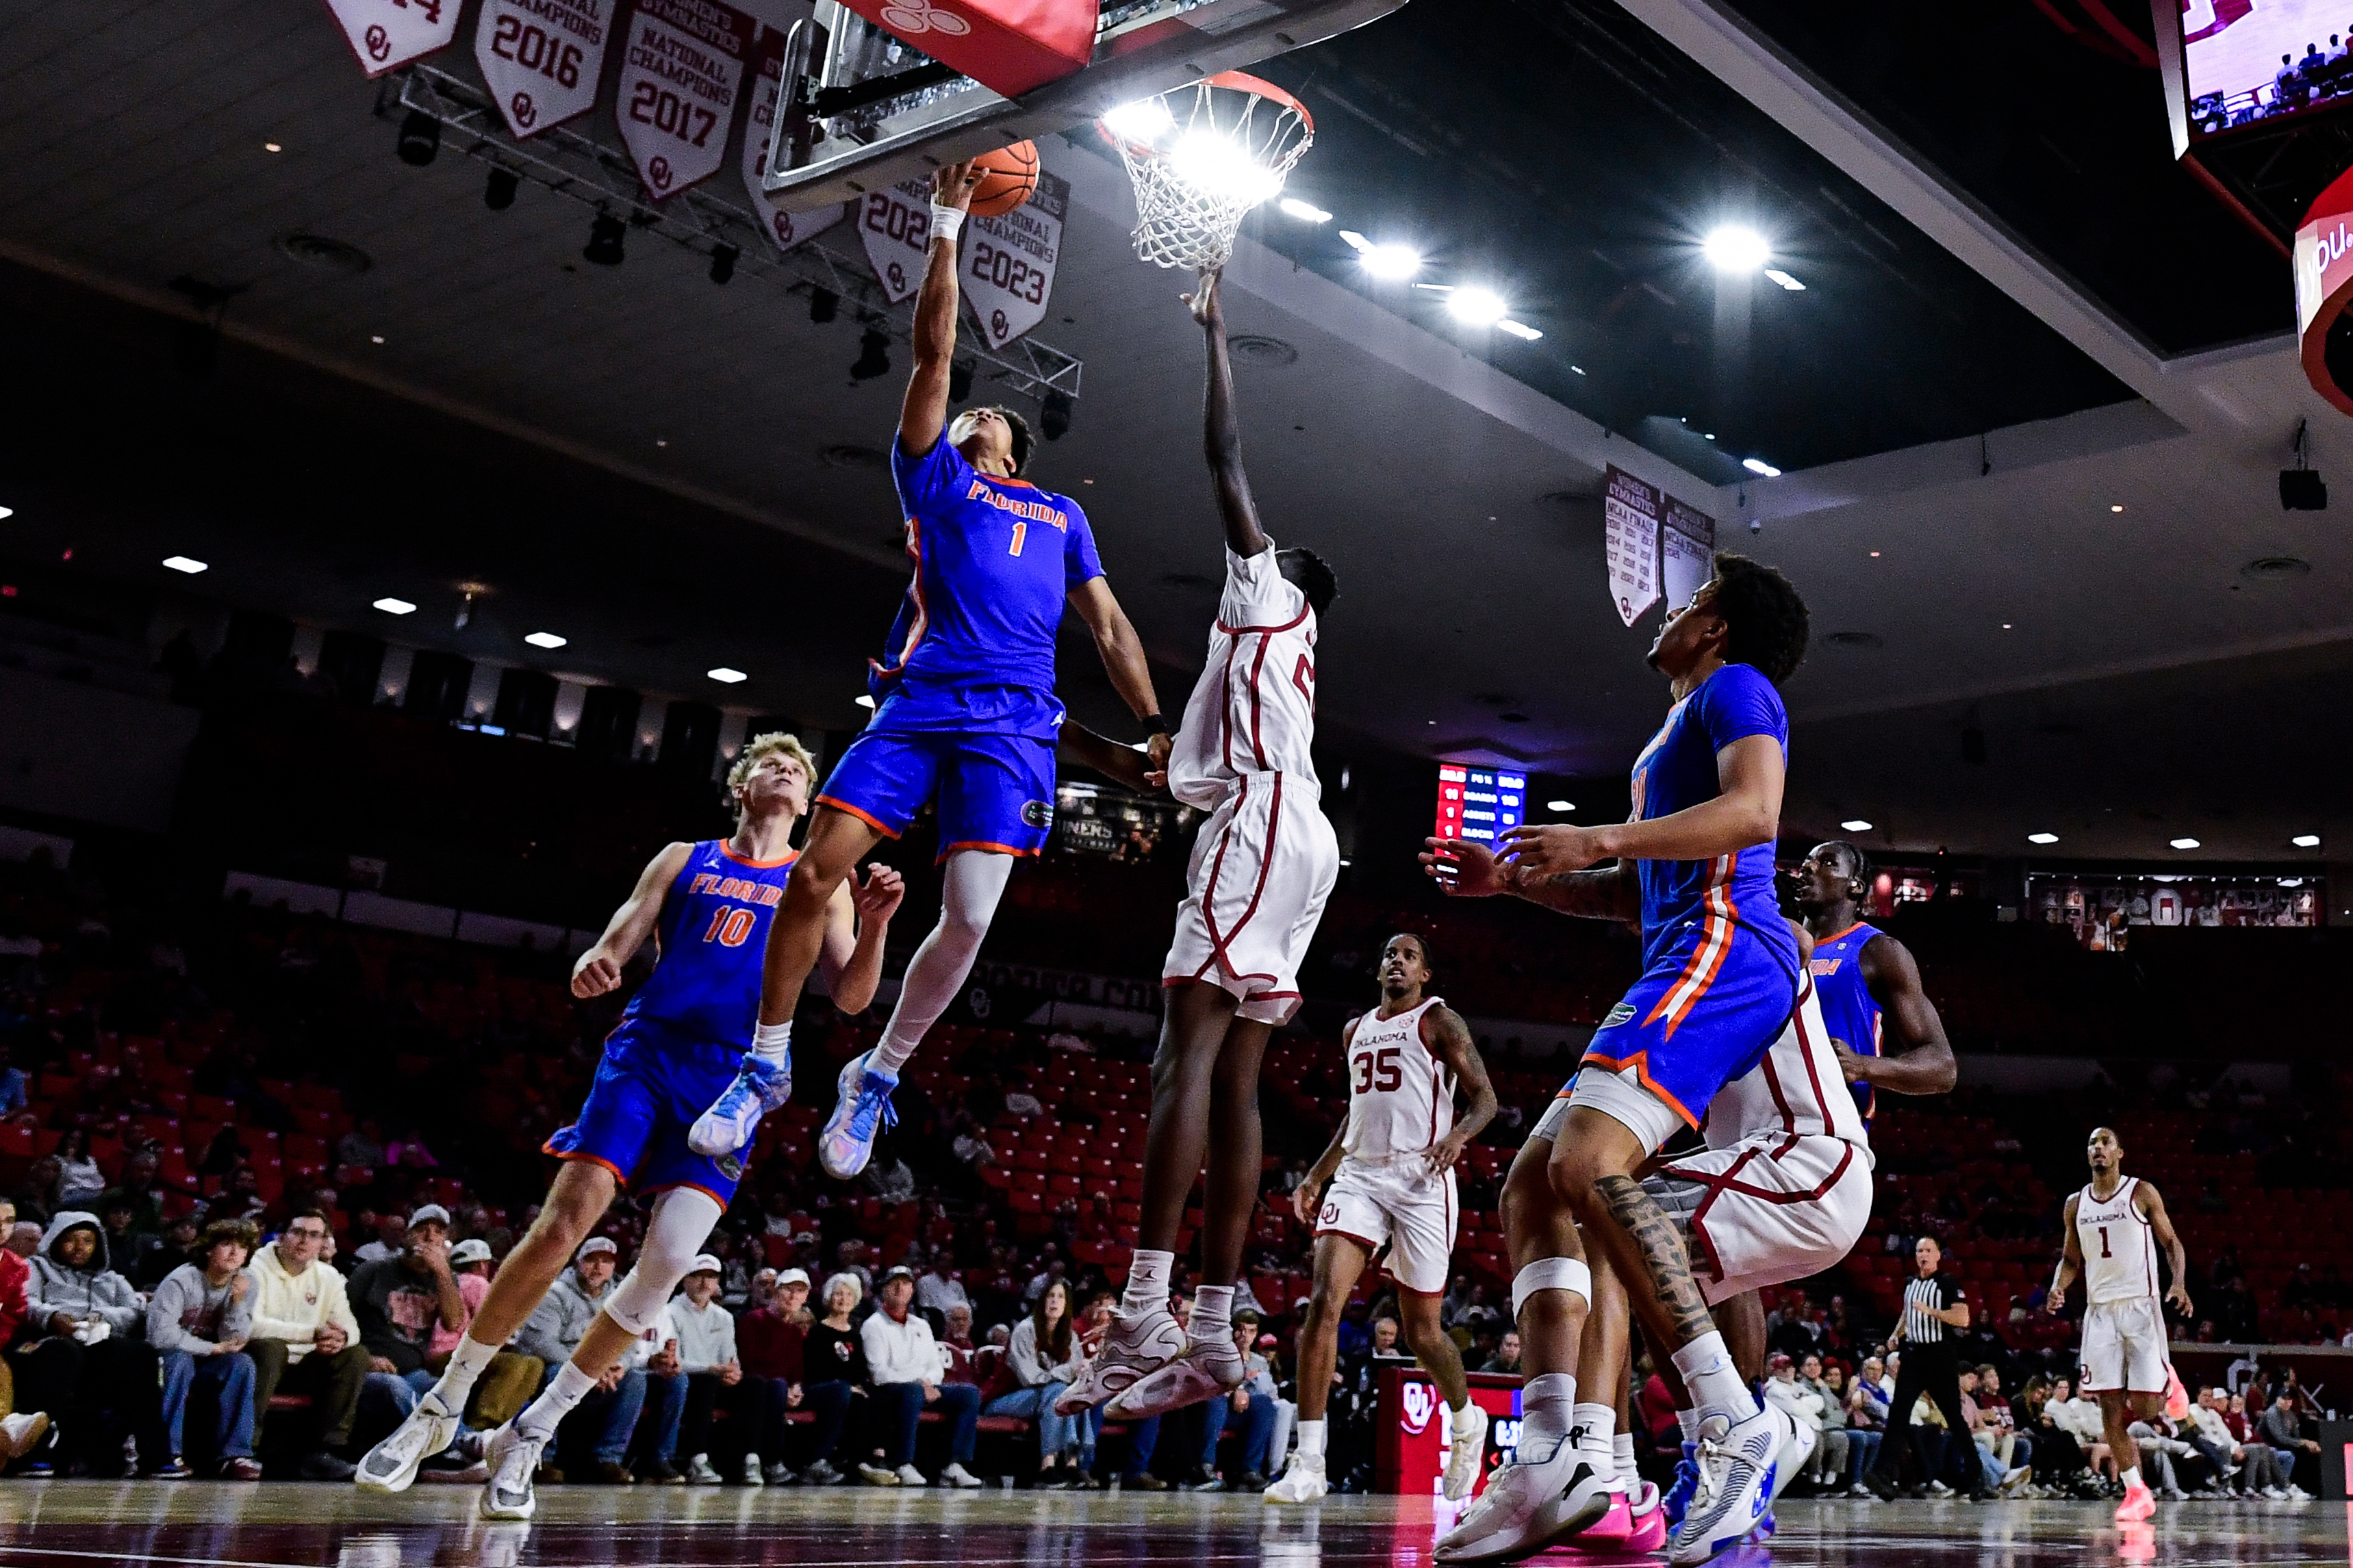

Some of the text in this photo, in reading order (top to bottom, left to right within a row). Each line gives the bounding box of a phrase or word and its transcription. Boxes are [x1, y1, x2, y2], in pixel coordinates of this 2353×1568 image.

[491, 14, 583, 89] 2016
[641, 28, 727, 84] NATIONAL
[629, 46, 733, 107] CHAMPIONS
[512, 92, 537, 127] OU
[630, 81, 717, 147] 2017
[649, 155, 673, 190] OU
[866, 192, 930, 255] 202
[971, 242, 1045, 305] 2023
[965, 479, 1069, 534] FLORIDA
[1008, 522, 1028, 557] 1
[688, 873, 784, 909] FLORID
[703, 905, 757, 948] 10
[1353, 1047, 1403, 1095] 35
[1321, 1202, 1340, 1225] OU
[2098, 1226, 2112, 1258] 1
